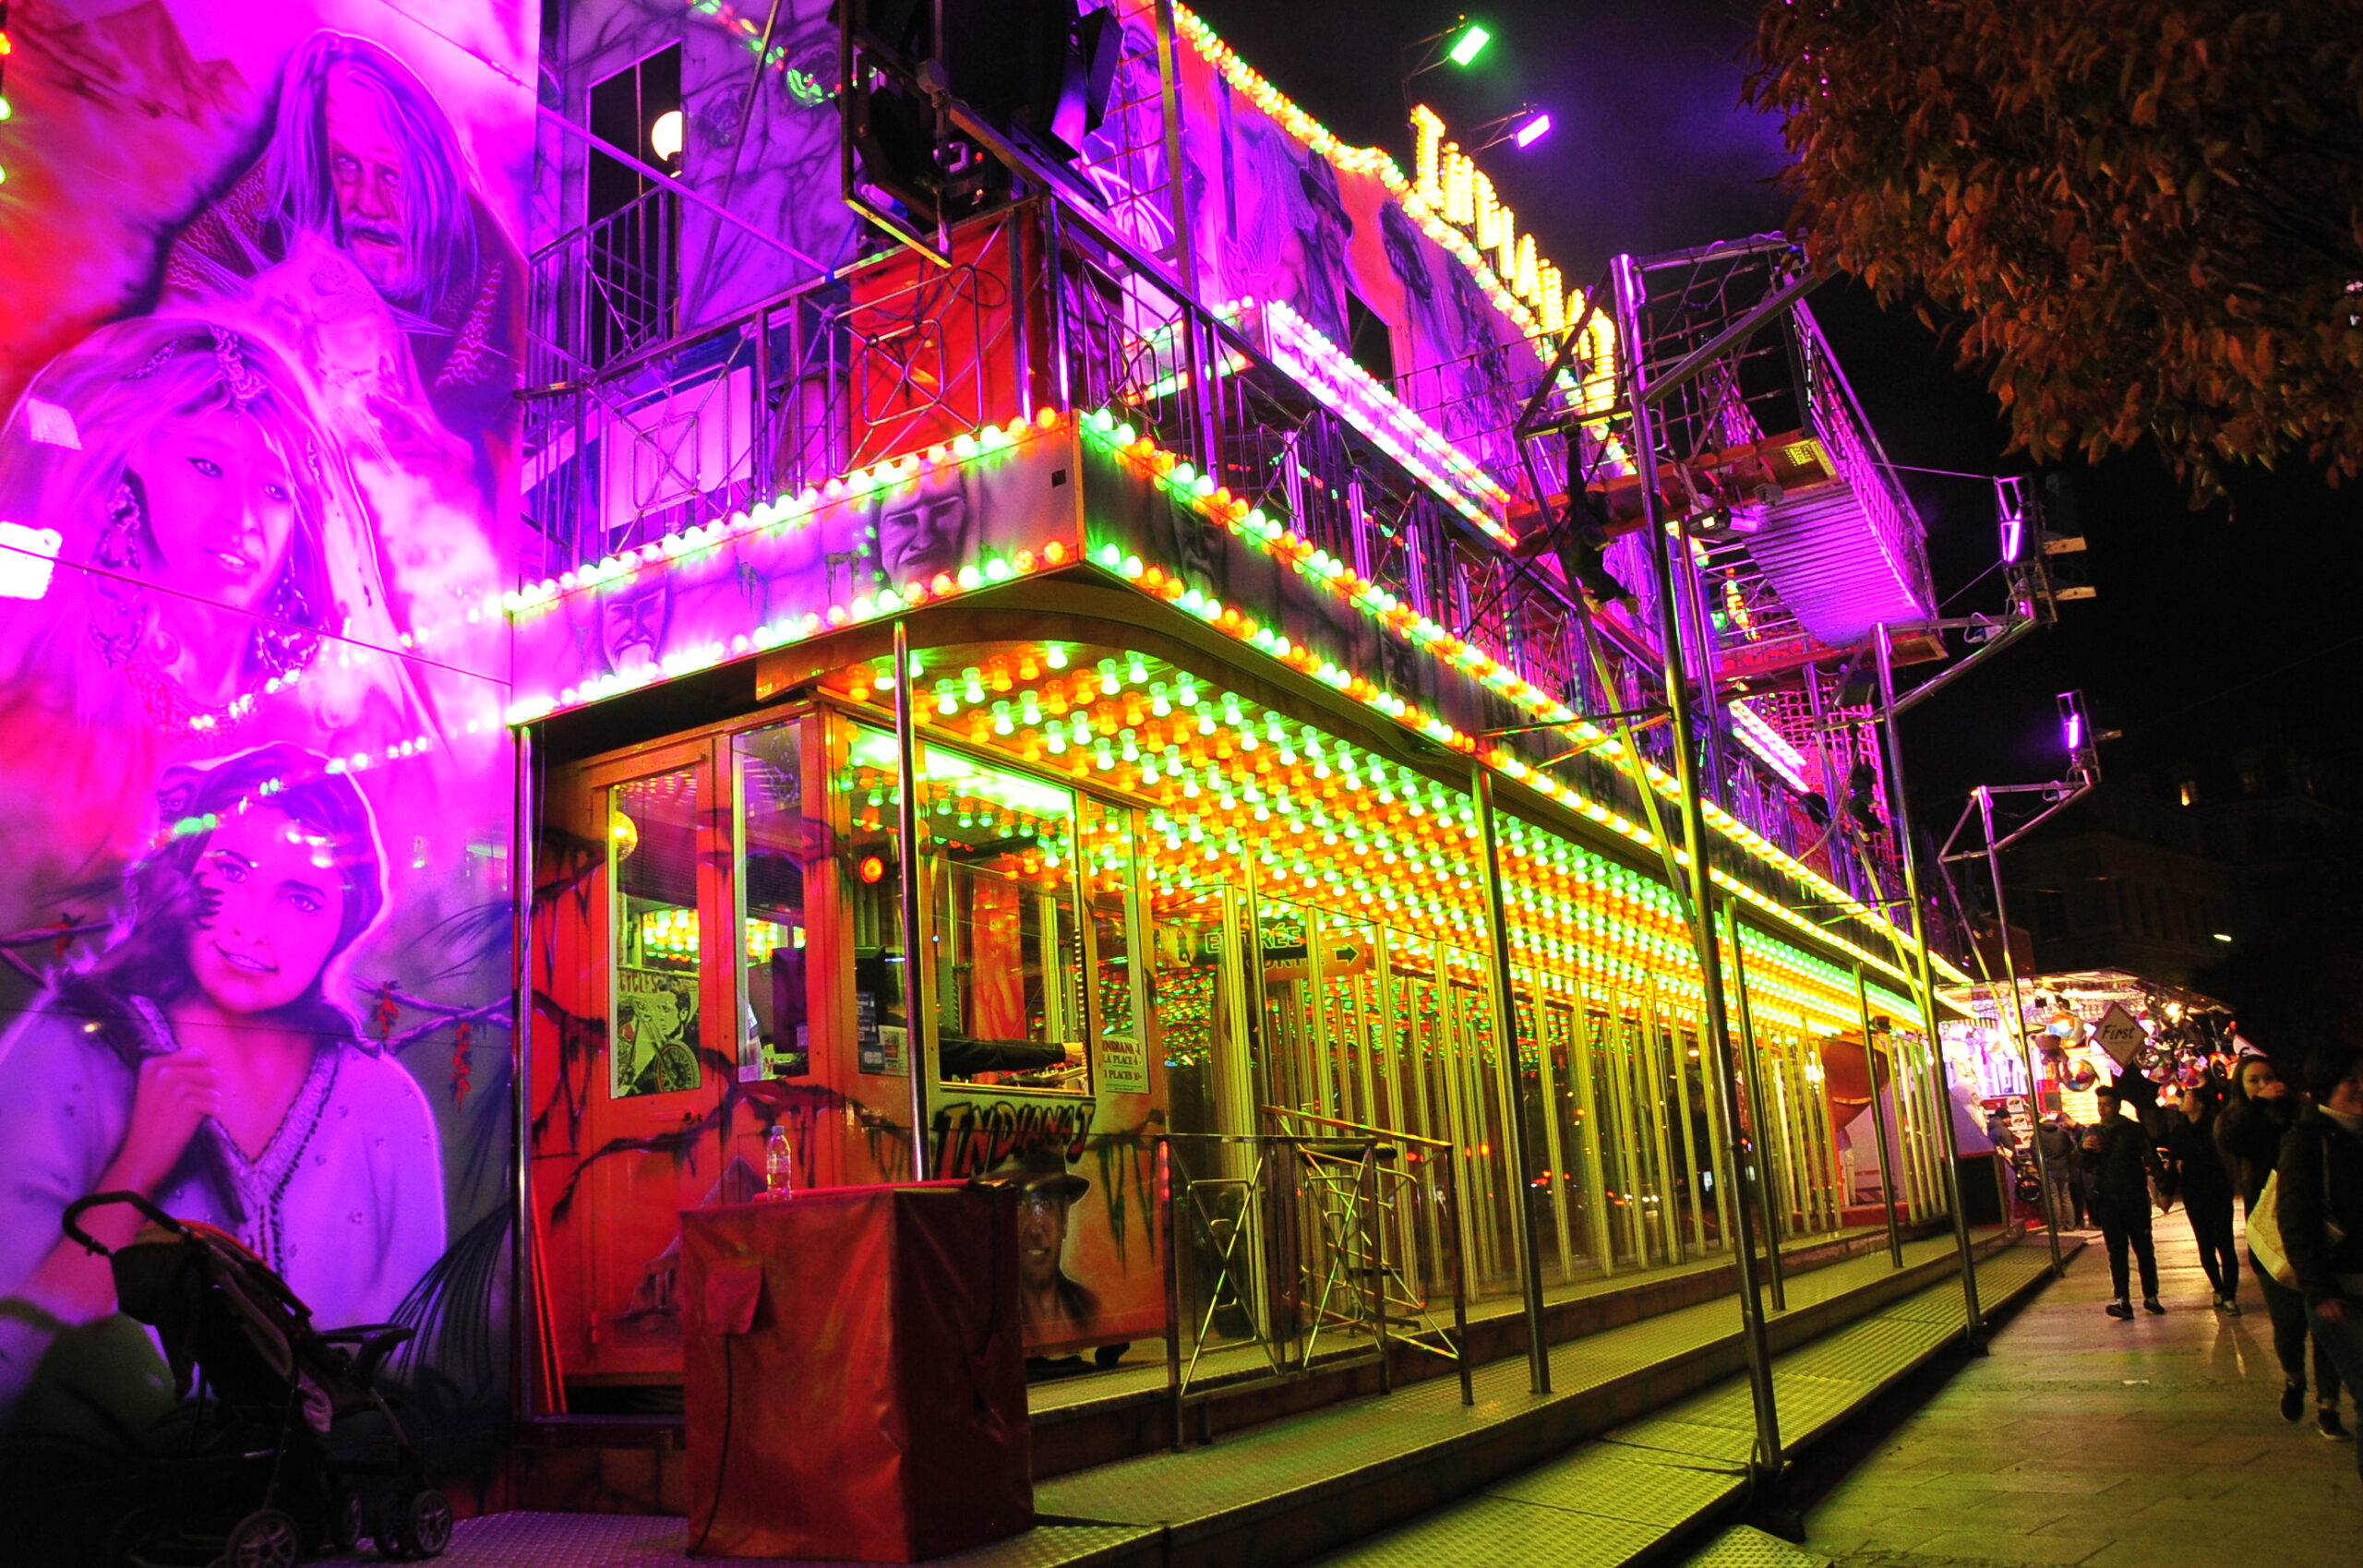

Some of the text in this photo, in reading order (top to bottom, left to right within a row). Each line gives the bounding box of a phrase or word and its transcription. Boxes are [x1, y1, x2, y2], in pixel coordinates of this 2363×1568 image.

[1205, 923, 1302, 953] ERÉE
[2101, 1023, 2135, 1039] First
[1113, 1055, 1133, 1064] PLACE
[1109, 1070, 1133, 1080] PLACES
[932, 1101, 1096, 1179] INDIANA J
